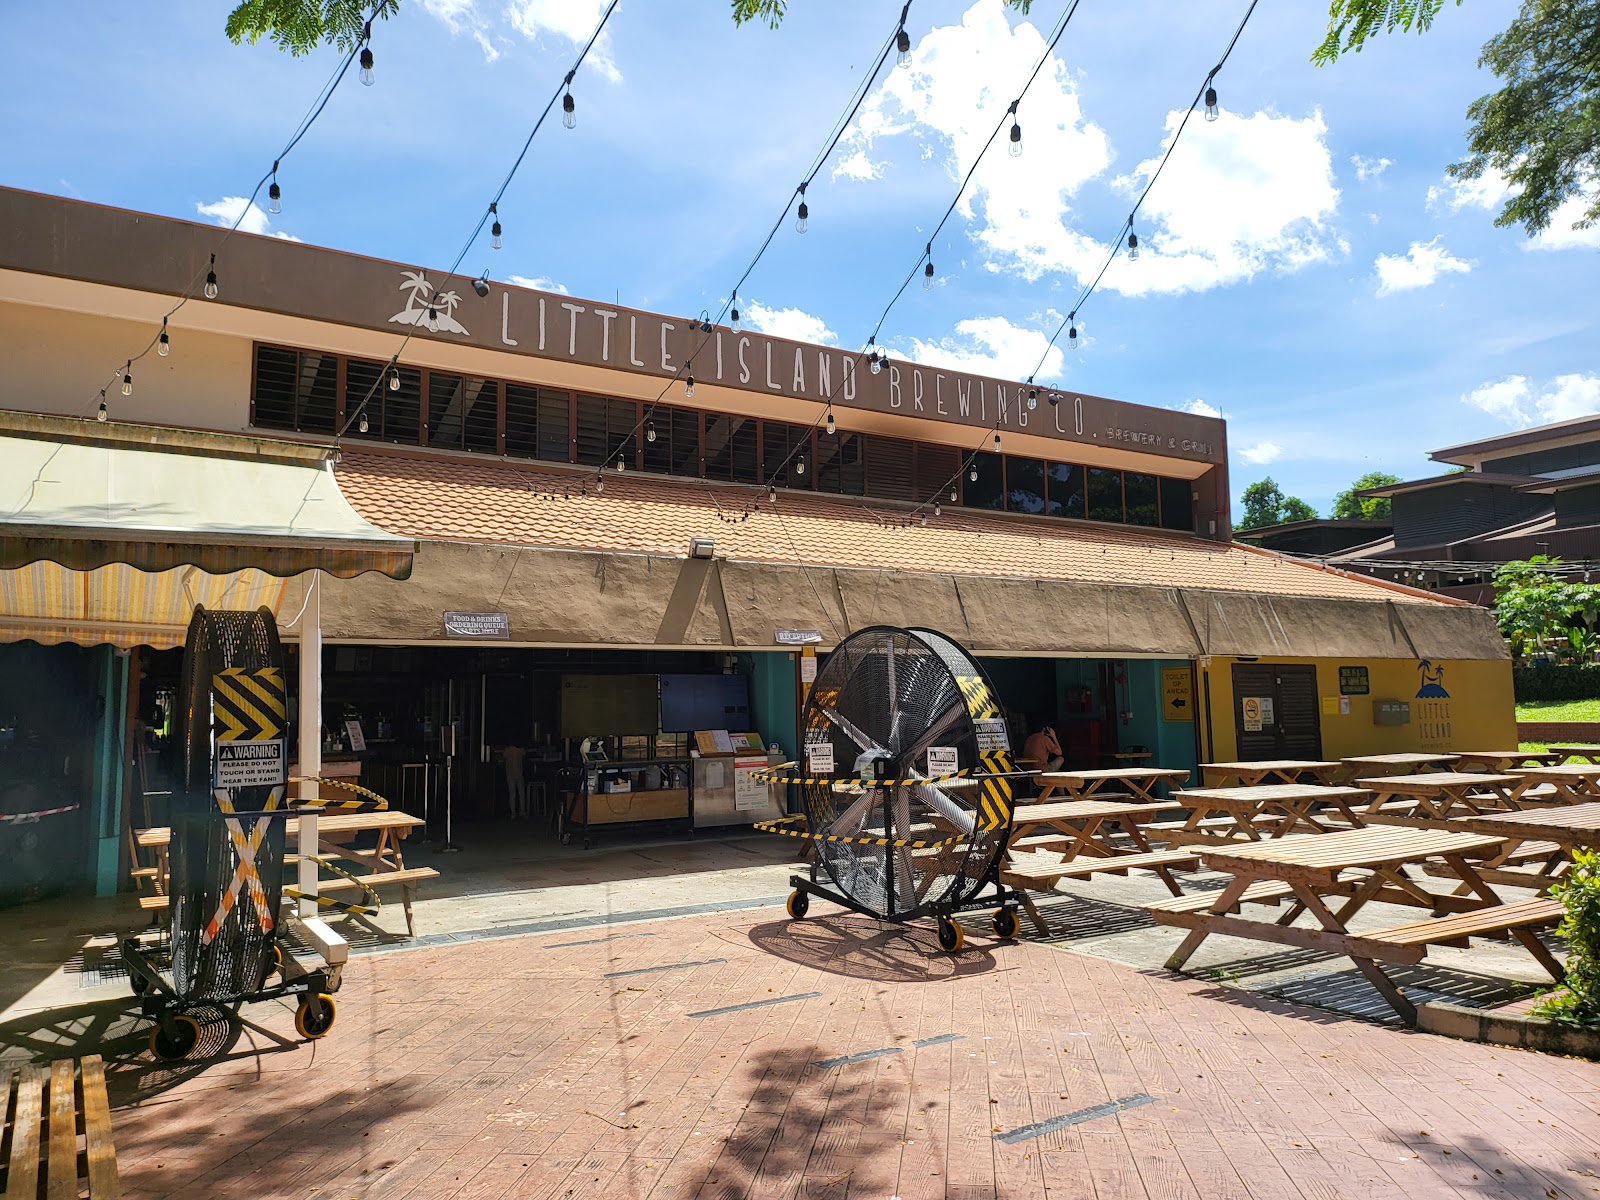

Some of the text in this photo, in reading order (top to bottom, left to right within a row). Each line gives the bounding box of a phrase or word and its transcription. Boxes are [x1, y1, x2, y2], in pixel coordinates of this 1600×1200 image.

[502, 291, 677, 372] LITTLE
[716, 331, 857, 401] ISLAND
[889, 364, 1029, 428] BREWING
[779, 632, 817, 640] RECEPTION
[1417, 703, 1450, 719] LITTLE
[1419, 722, 1452, 738] ISLAND
[234, 744, 278, 759] WARNING
